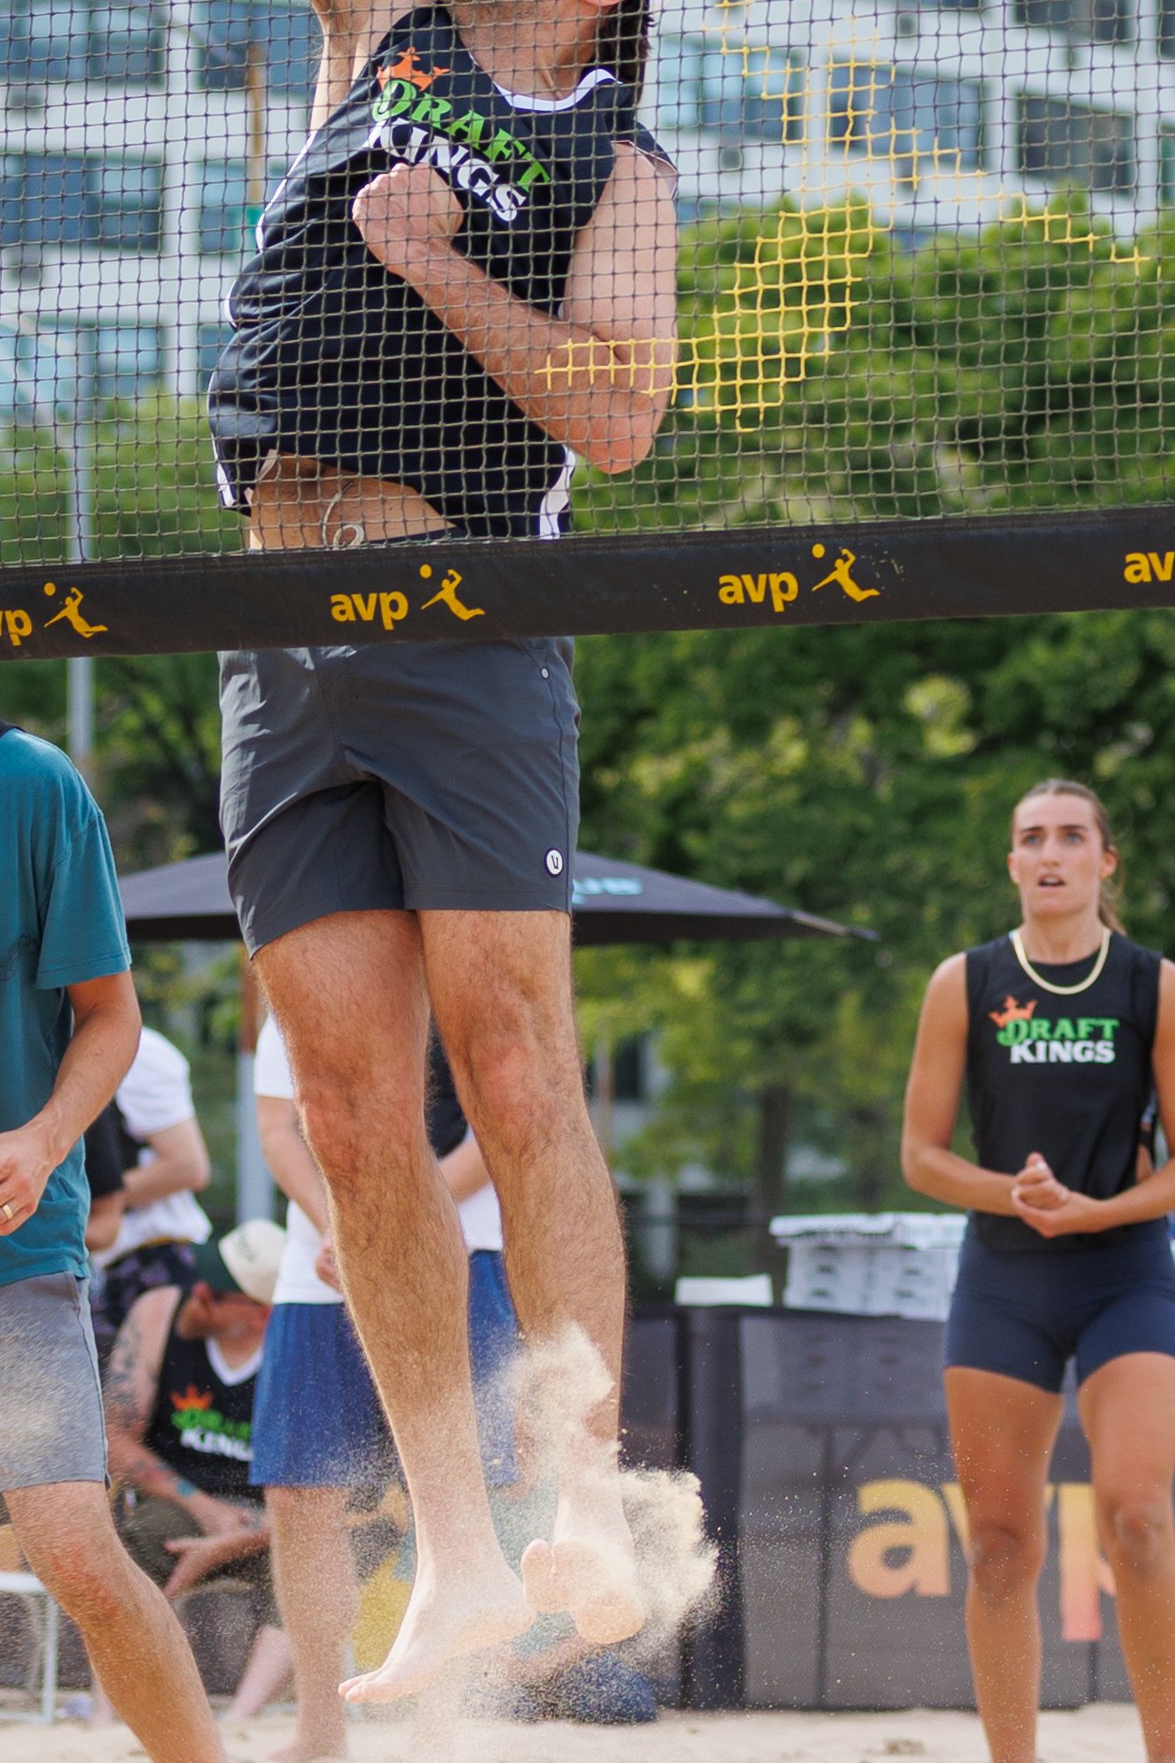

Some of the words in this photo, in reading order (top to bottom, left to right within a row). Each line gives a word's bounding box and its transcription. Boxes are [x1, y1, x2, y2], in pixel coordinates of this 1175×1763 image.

[371, 79, 551, 194] DRAFT
[330, 591, 409, 631] avp
[718, 571, 799, 613] avp
[997, 1017, 1120, 1046] DRAFT
[1010, 1039, 1116, 1064] KINGS
